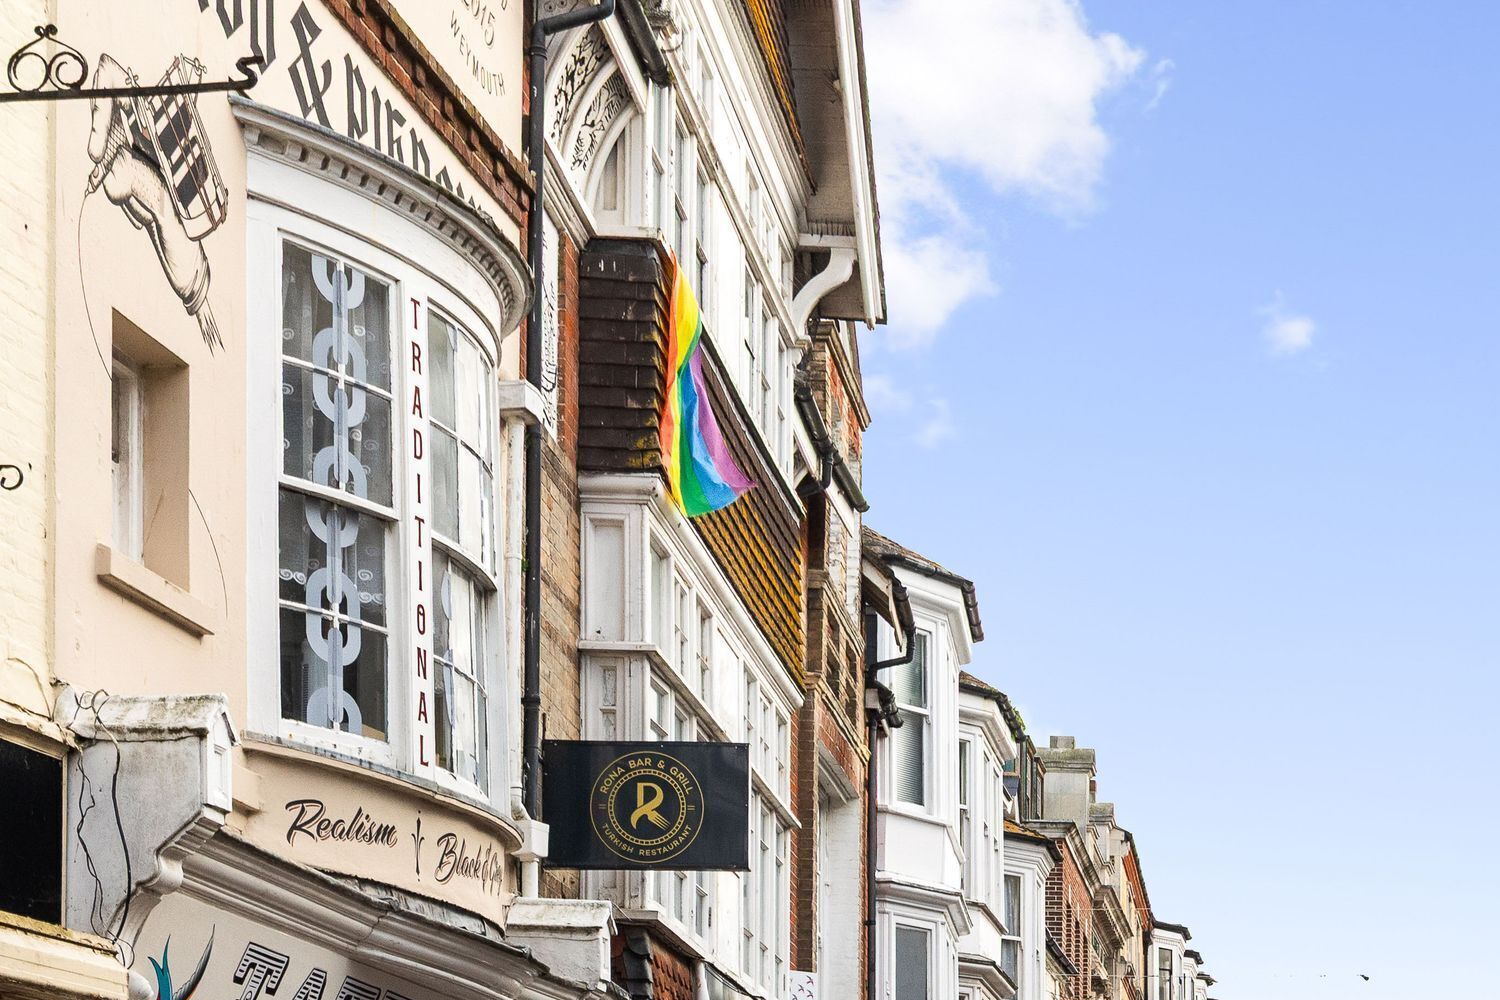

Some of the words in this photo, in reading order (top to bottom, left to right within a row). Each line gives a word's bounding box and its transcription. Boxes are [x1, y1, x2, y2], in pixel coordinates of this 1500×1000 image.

[450, 9, 506, 97] WEYMOUTH
[410, 296, 430, 768] TRADITIONAL
[600, 767, 626, 794] RONA
[628, 757, 653, 770] BAR
[657, 760, 666, 770] &
[669, 766, 695, 795] GRILL
[285, 799, 398, 847] Realism
[434, 833, 482, 885] Black
[602, 823, 634, 854] TURKISH
[639, 824, 693, 857] RESTAURANT
